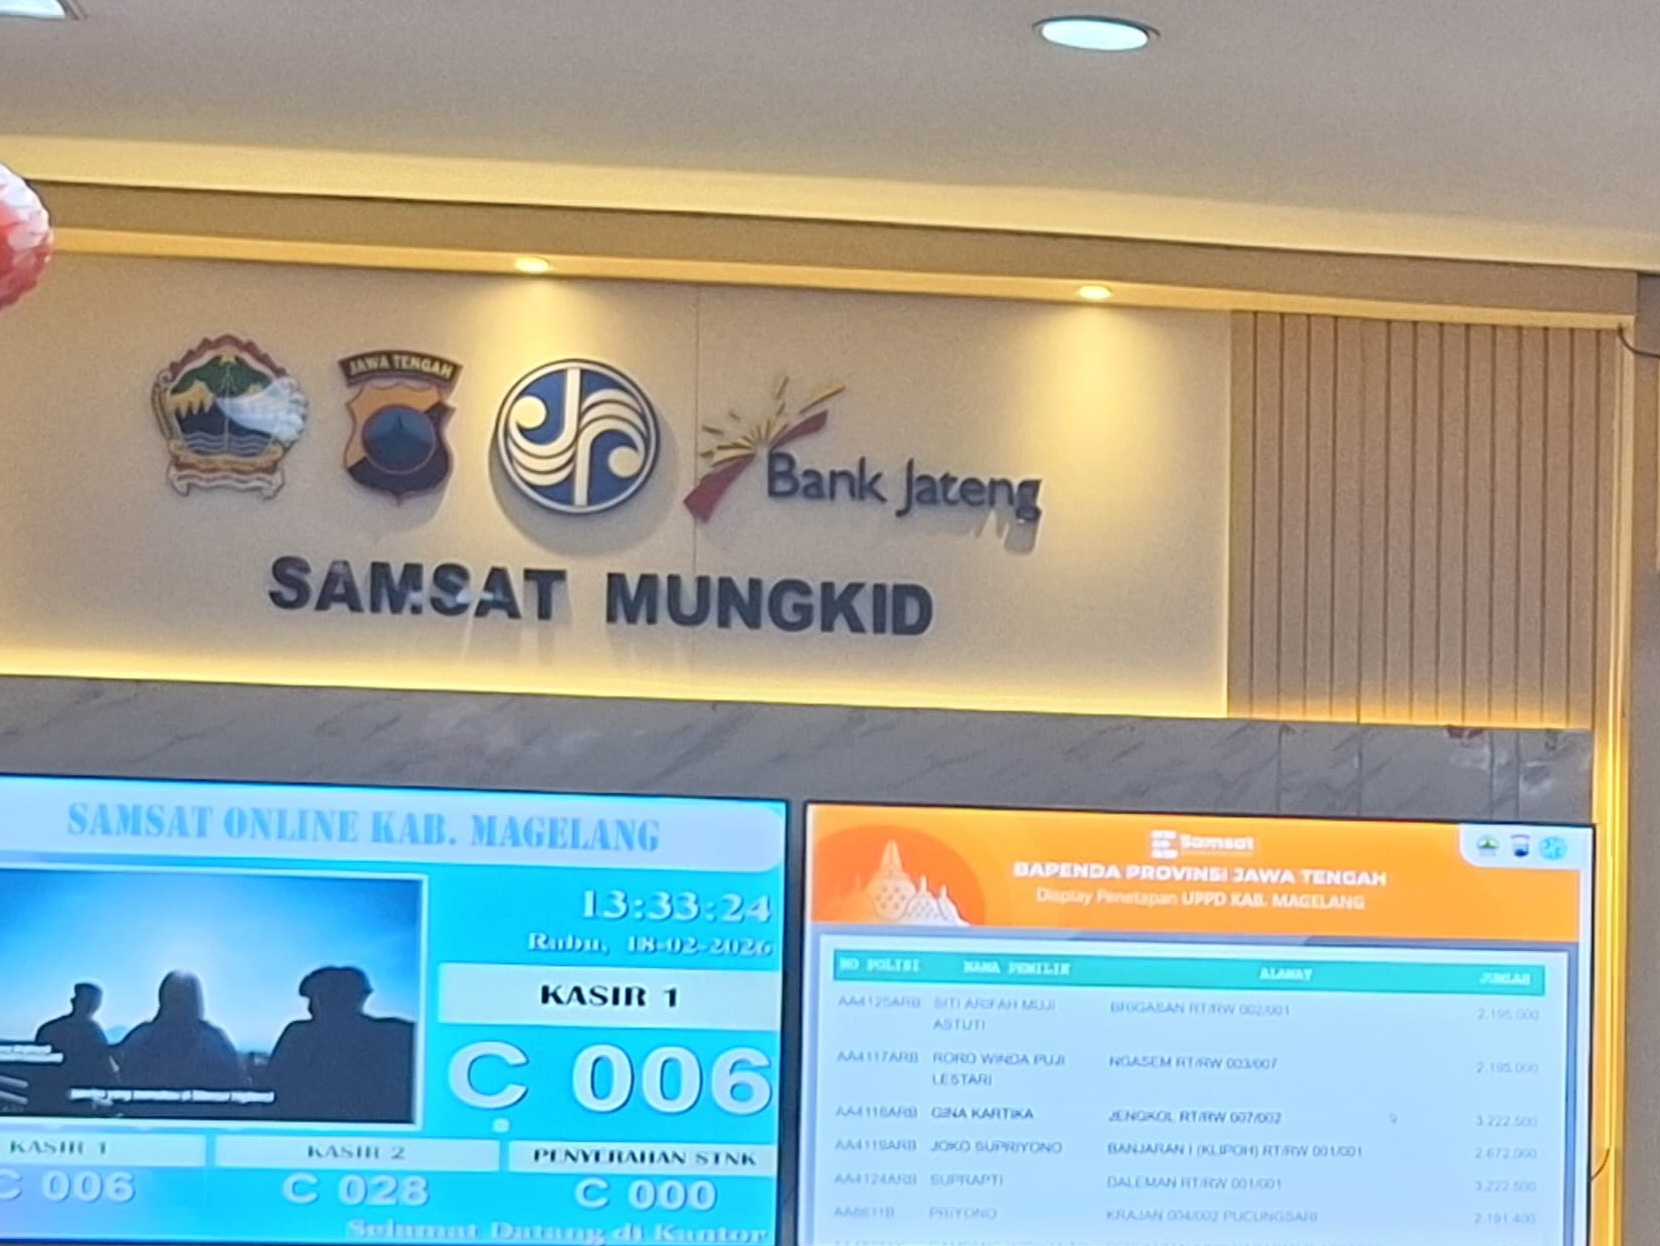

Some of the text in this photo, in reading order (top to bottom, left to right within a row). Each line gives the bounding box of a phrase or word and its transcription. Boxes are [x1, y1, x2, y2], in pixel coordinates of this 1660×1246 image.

[348, 354, 455, 378] JAWA TENGAH
[766, 453, 1042, 524] Bank Jateng
[268, 554, 934, 636] SAMSAT MUNGKID
[67, 801, 660, 852] SAMSAT ONLINE KAB. MAGELANG
[1181, 834, 1254, 850] Samsat
[1013, 861, 1387, 887] BAPENDA PROVINSI JAWA TENGAH
[583, 889, 771, 923] 13:33:24
[1036, 886, 1092, 906] Display
[1097, 888, 1178, 909] Penetapan
[1181, 891, 1227, 907] UPPD
[1271, 893, 1366, 910] MAGELANG
[528, 932, 773, 956] Rabu, 18-02-2026
[867, 959, 920, 973] POLISI
[540, 984, 679, 1009] KASIR 1
[448, 1041, 774, 1115] C 006
[971, 1107, 1034, 1121] KARTIKA
[10, 1140, 84, 1155] KASIR
[307, 1144, 406, 1161] KASIR 2
[533, 1148, 757, 1167] PENYERAHAN STNK
[42, 1169, 136, 1202] 006
[282, 1173, 430, 1207] C 028
[574, 1177, 718, 1211] C 000
[347, 1219, 769, 1246] Selamat Datang di Kantor
